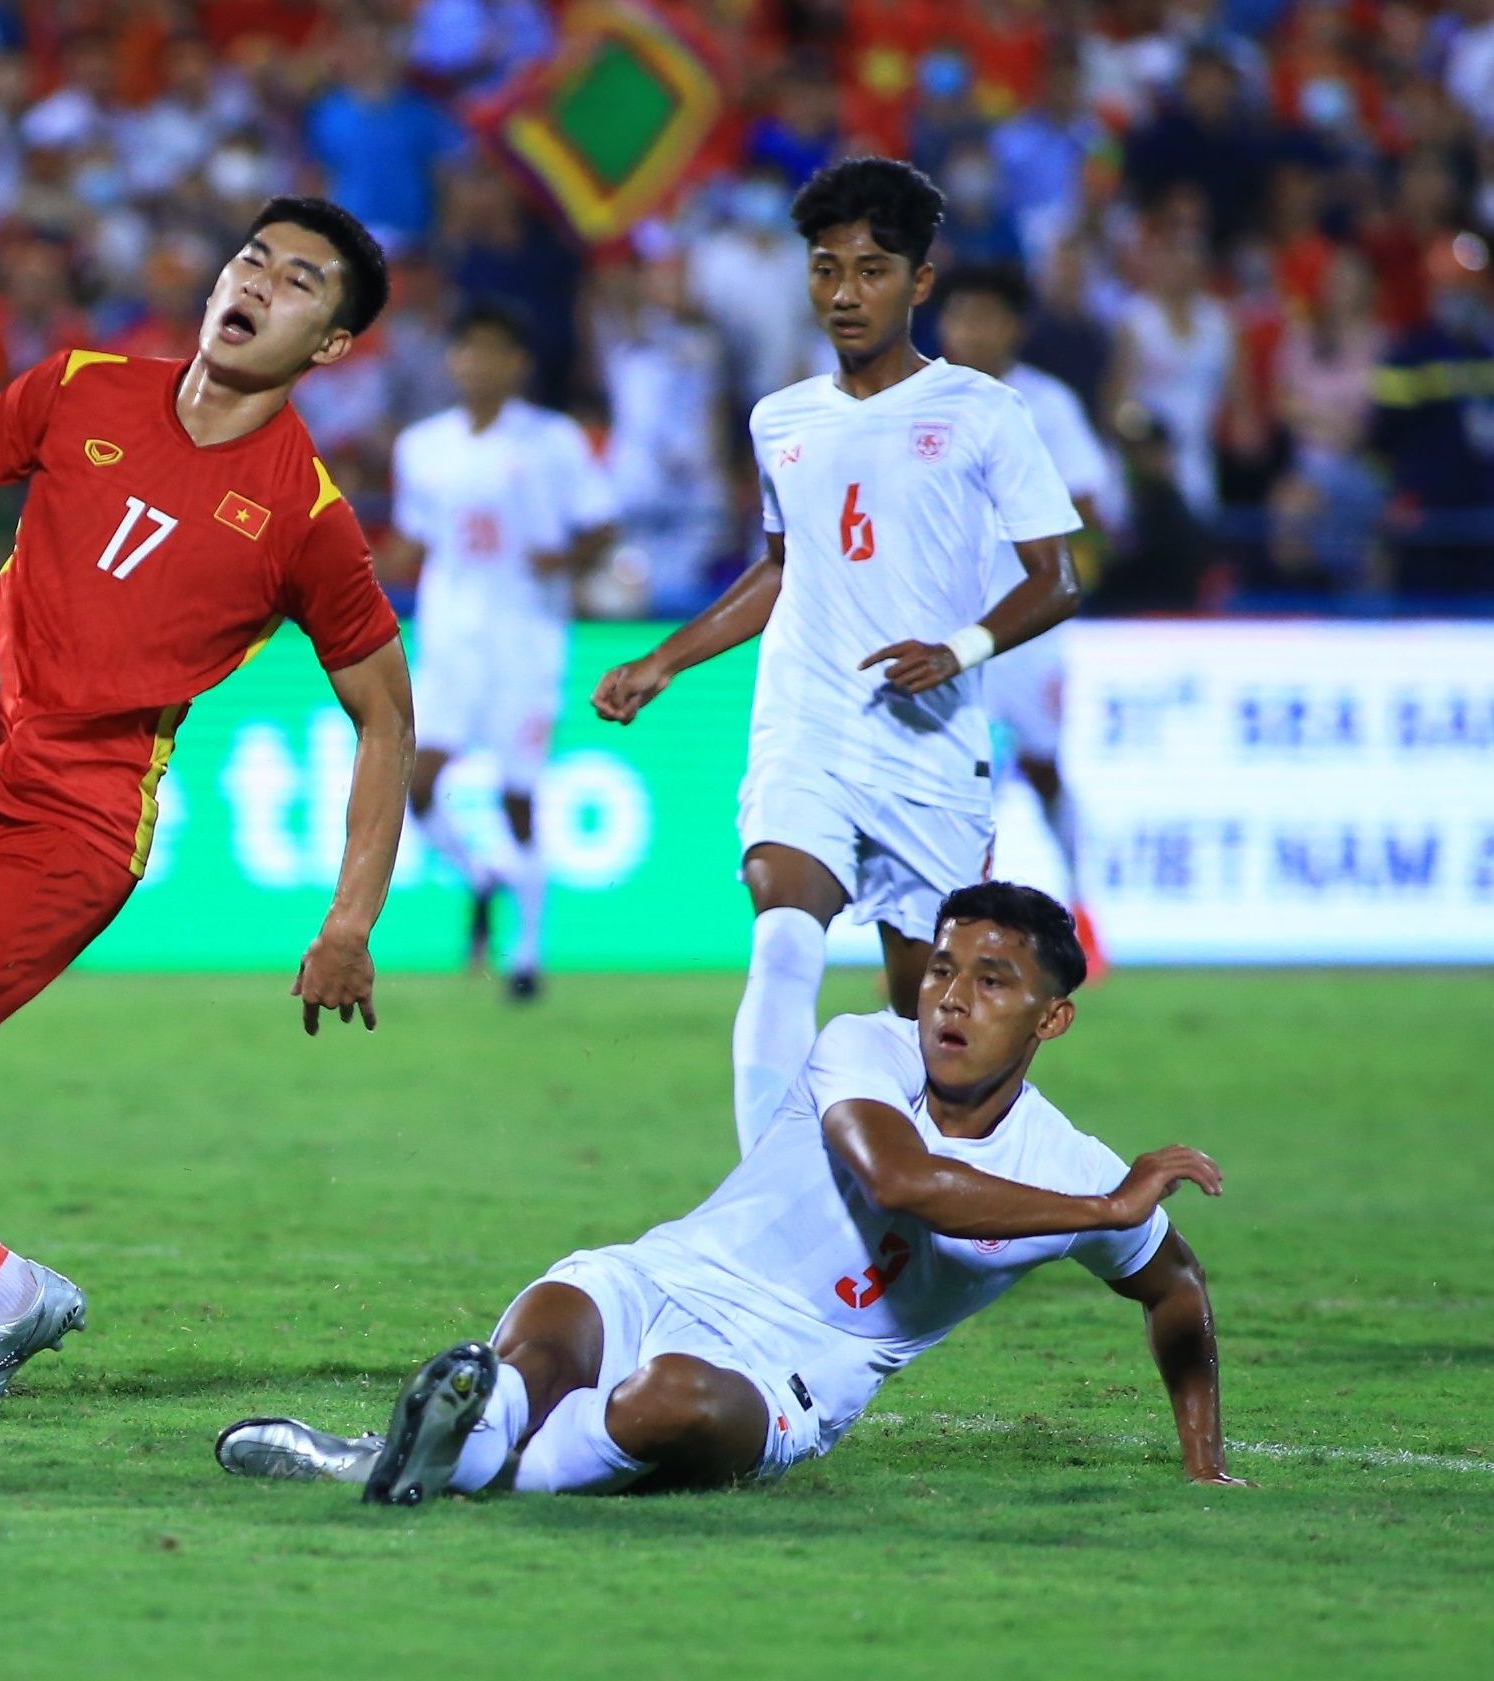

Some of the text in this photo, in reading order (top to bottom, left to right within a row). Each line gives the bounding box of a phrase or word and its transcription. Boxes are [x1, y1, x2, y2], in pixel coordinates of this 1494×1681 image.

[96, 495, 179, 581] 17
[839, 481, 876, 562] 6
[834, 1232, 910, 1309] 3
